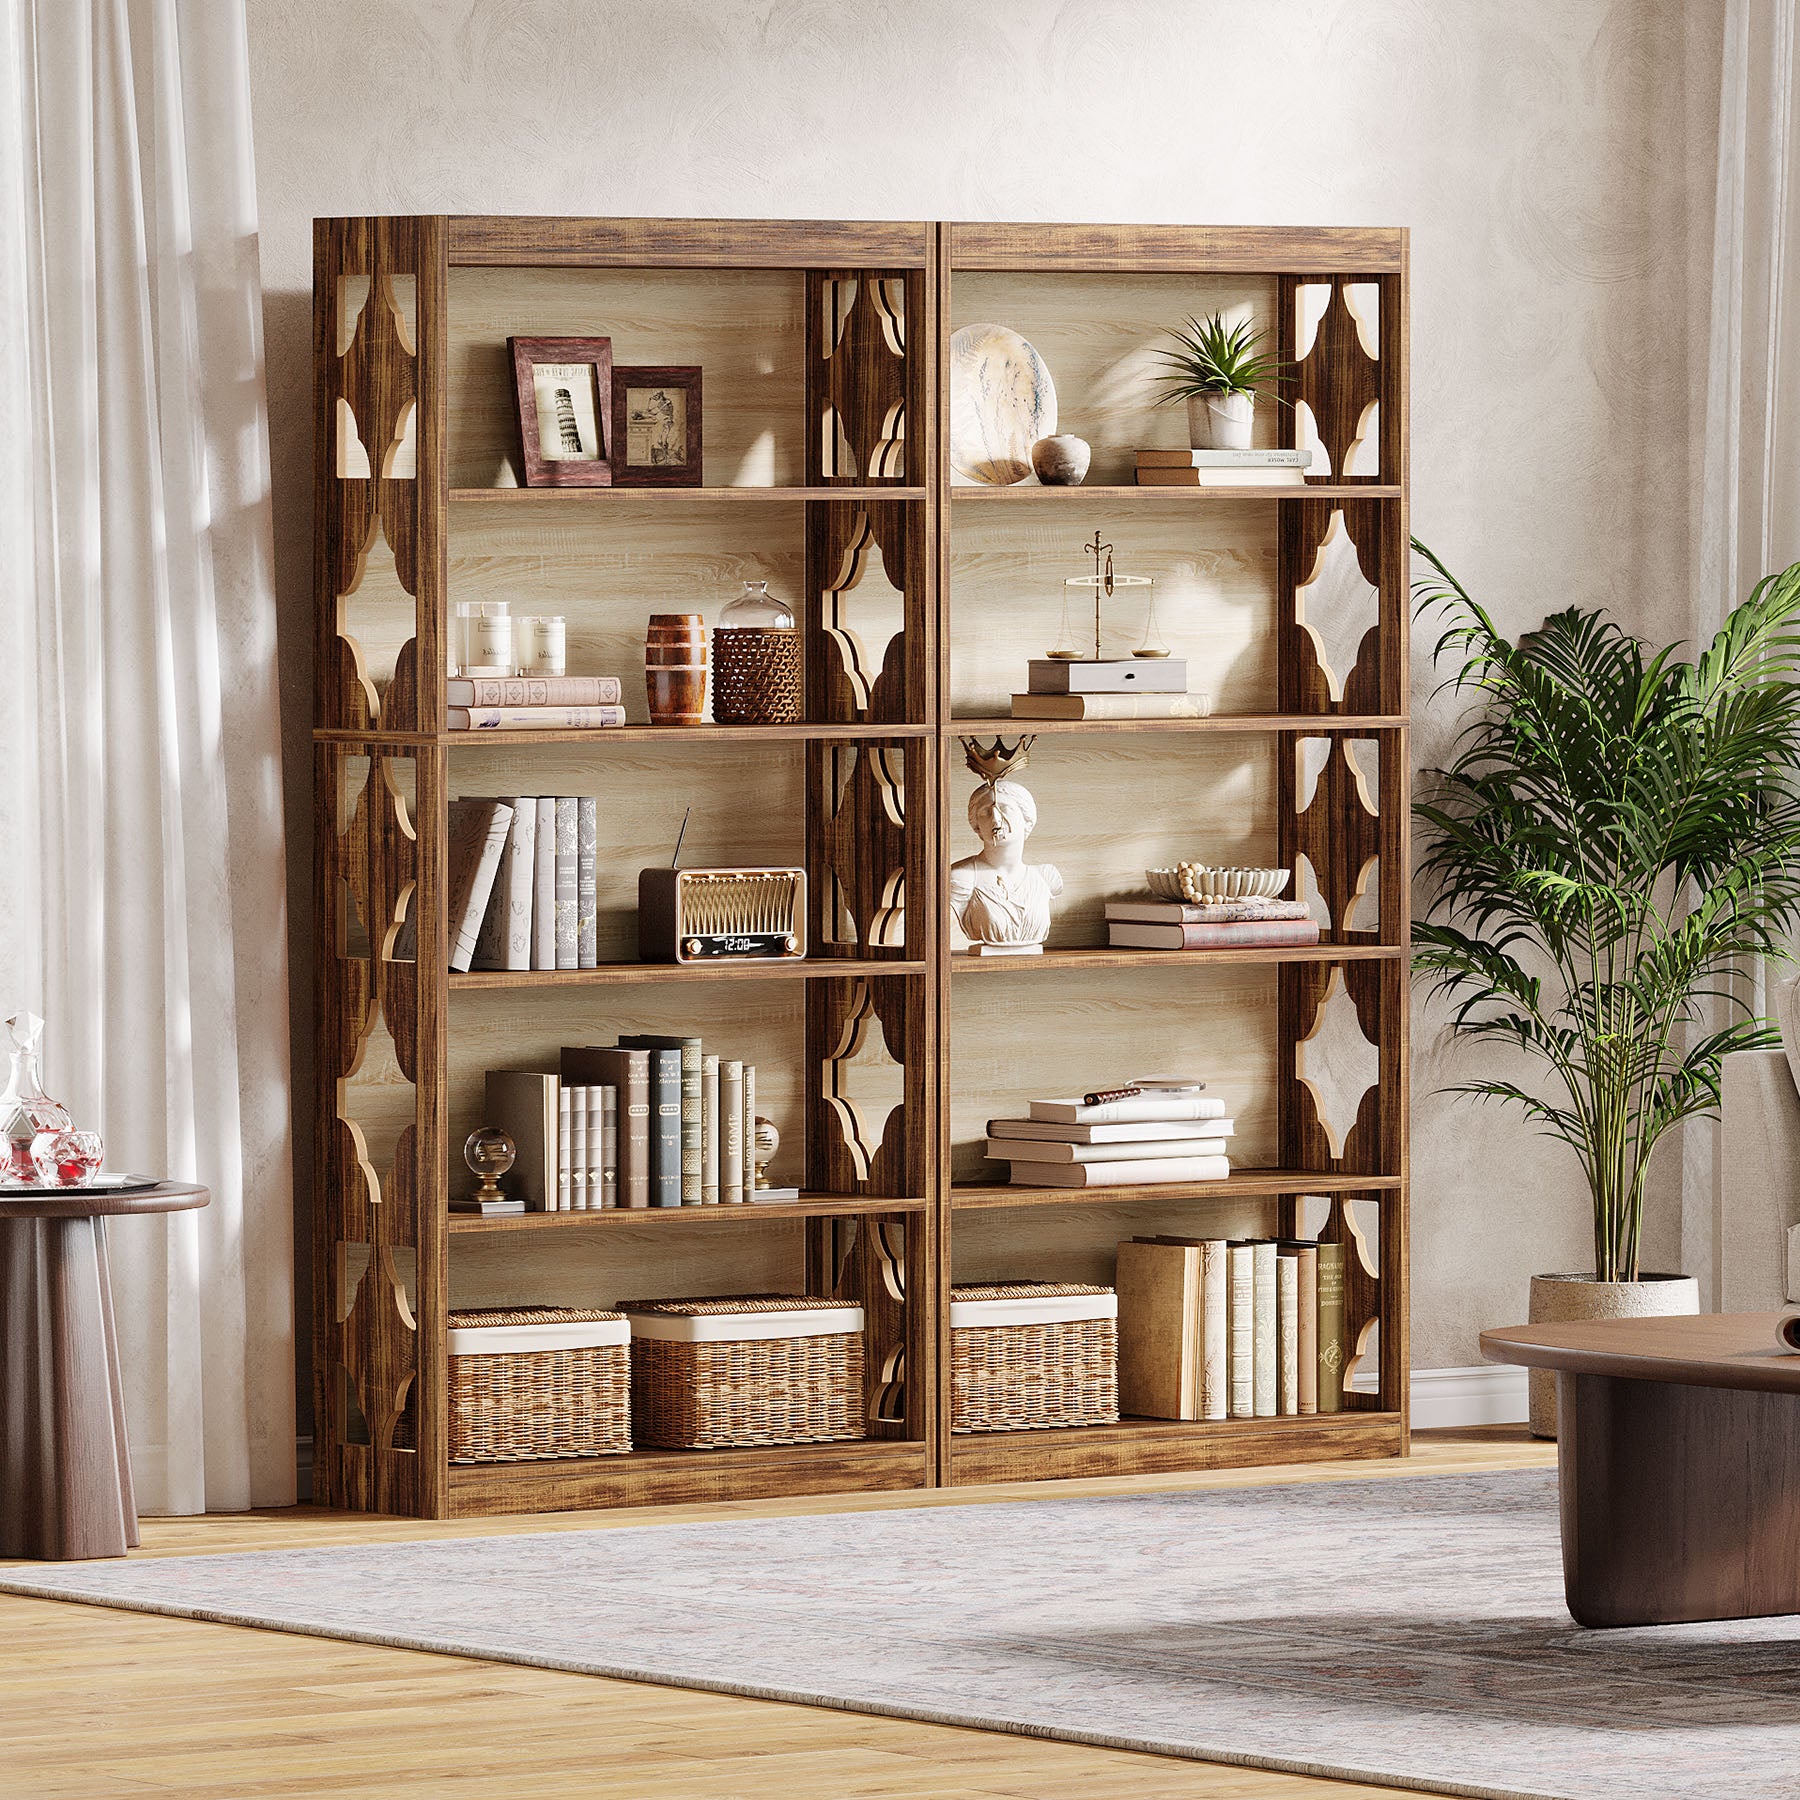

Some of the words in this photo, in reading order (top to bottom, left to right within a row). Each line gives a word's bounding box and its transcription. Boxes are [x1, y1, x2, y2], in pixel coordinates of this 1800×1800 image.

[728, 1112, 738, 1156] HOME
[745, 1110, 753, 1135] THINGS
[745, 1149, 753, 1166] LOVE
